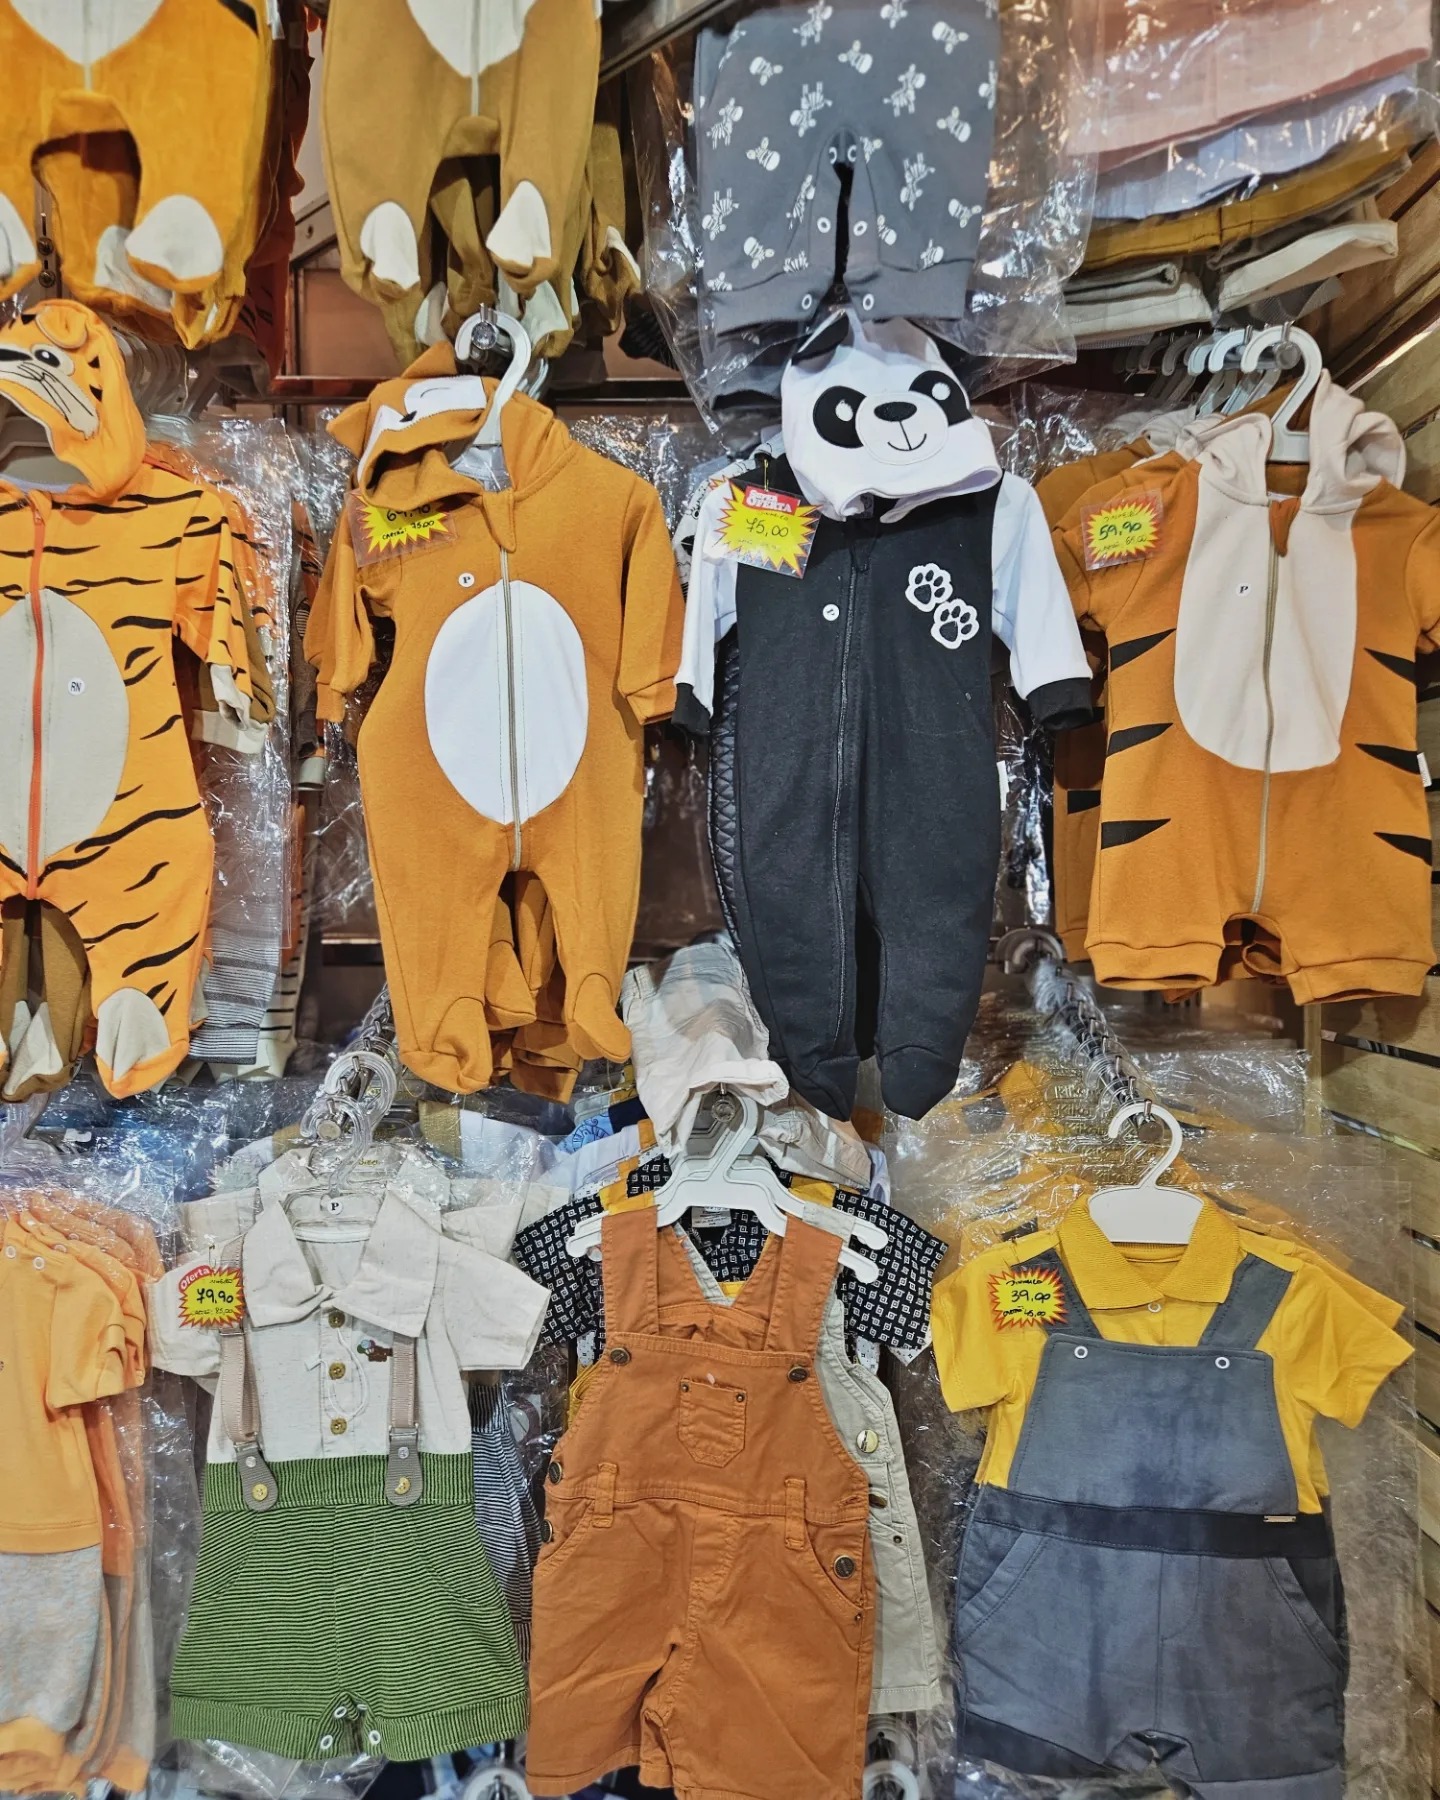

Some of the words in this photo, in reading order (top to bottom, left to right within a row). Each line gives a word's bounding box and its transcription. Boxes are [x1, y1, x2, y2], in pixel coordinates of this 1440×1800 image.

[745, 496, 793, 513] OFERTA
[70, 681, 83, 692] RN
[331, 1202, 340, 1211] P
[180, 1267, 210, 1290] Oferta
